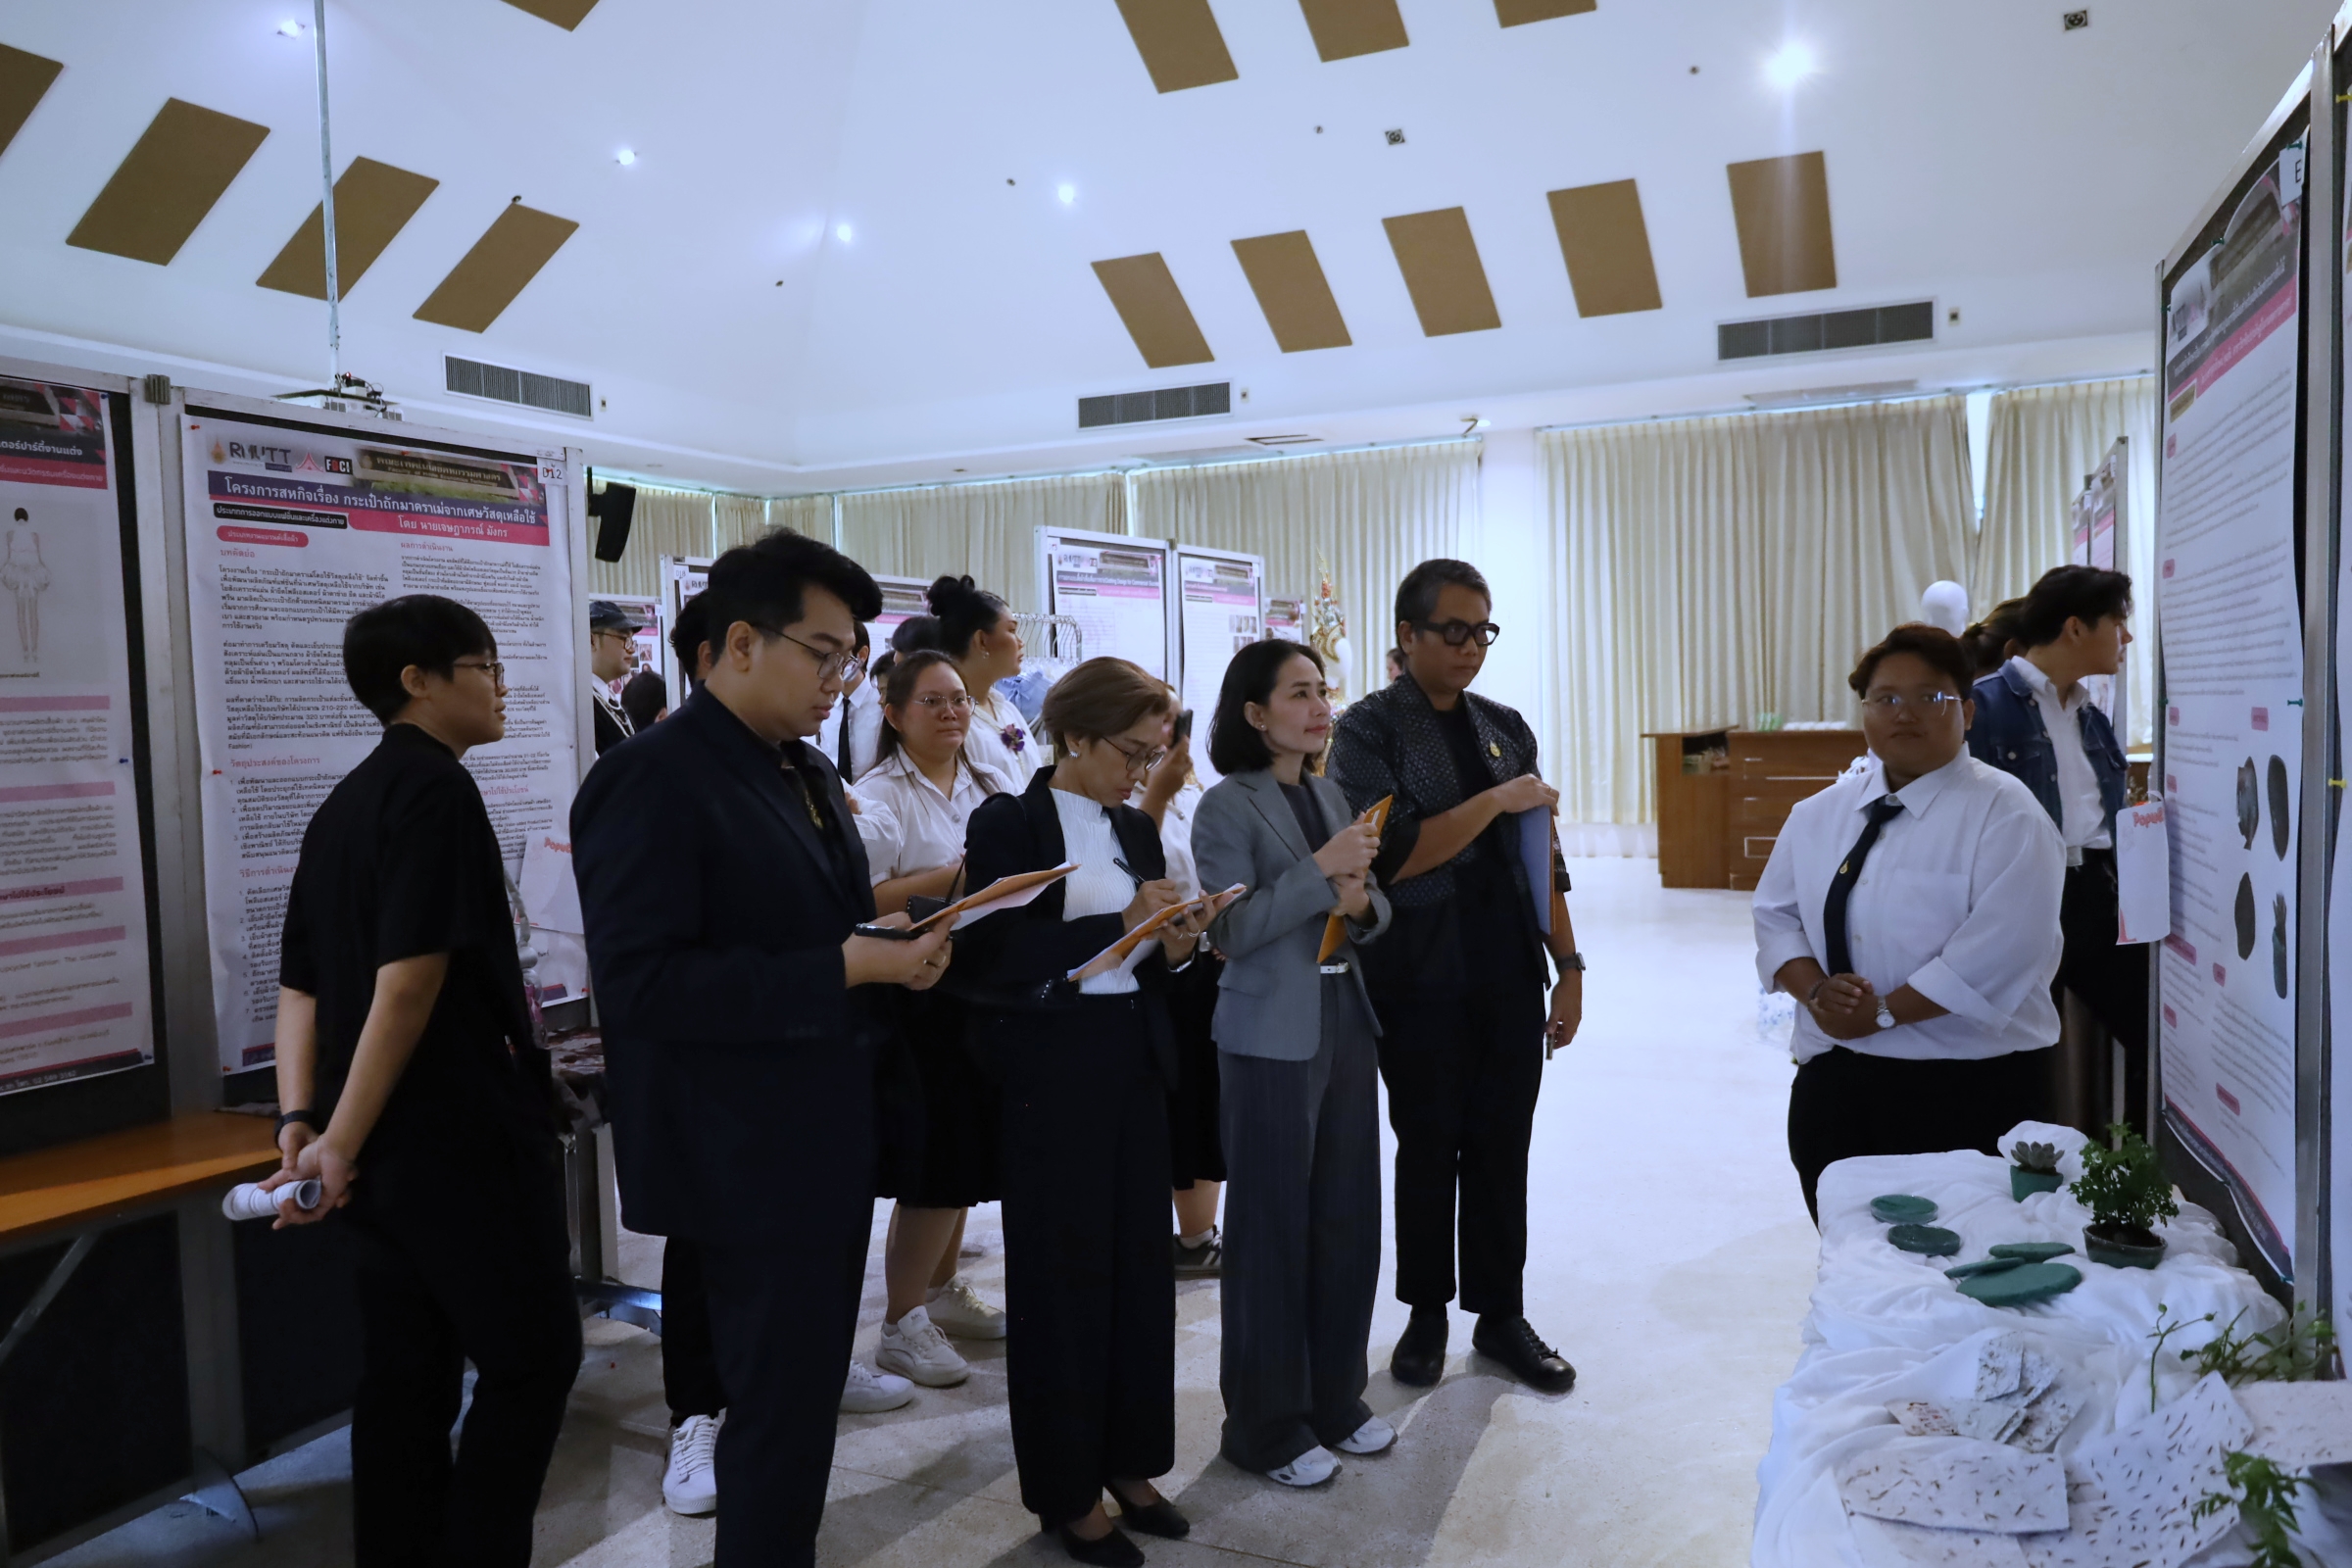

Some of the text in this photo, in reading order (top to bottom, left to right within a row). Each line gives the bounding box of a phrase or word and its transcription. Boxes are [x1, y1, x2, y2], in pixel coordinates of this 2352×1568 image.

[0, 440, 83, 456] ตอร์ปาร์ตี้งานแต่ง
[224, 476, 339, 505] โครงการสหกิจเรื่อง
[398, 515, 417, 529] โดย
[220, 548, 255, 558] บทคัดย่อ
